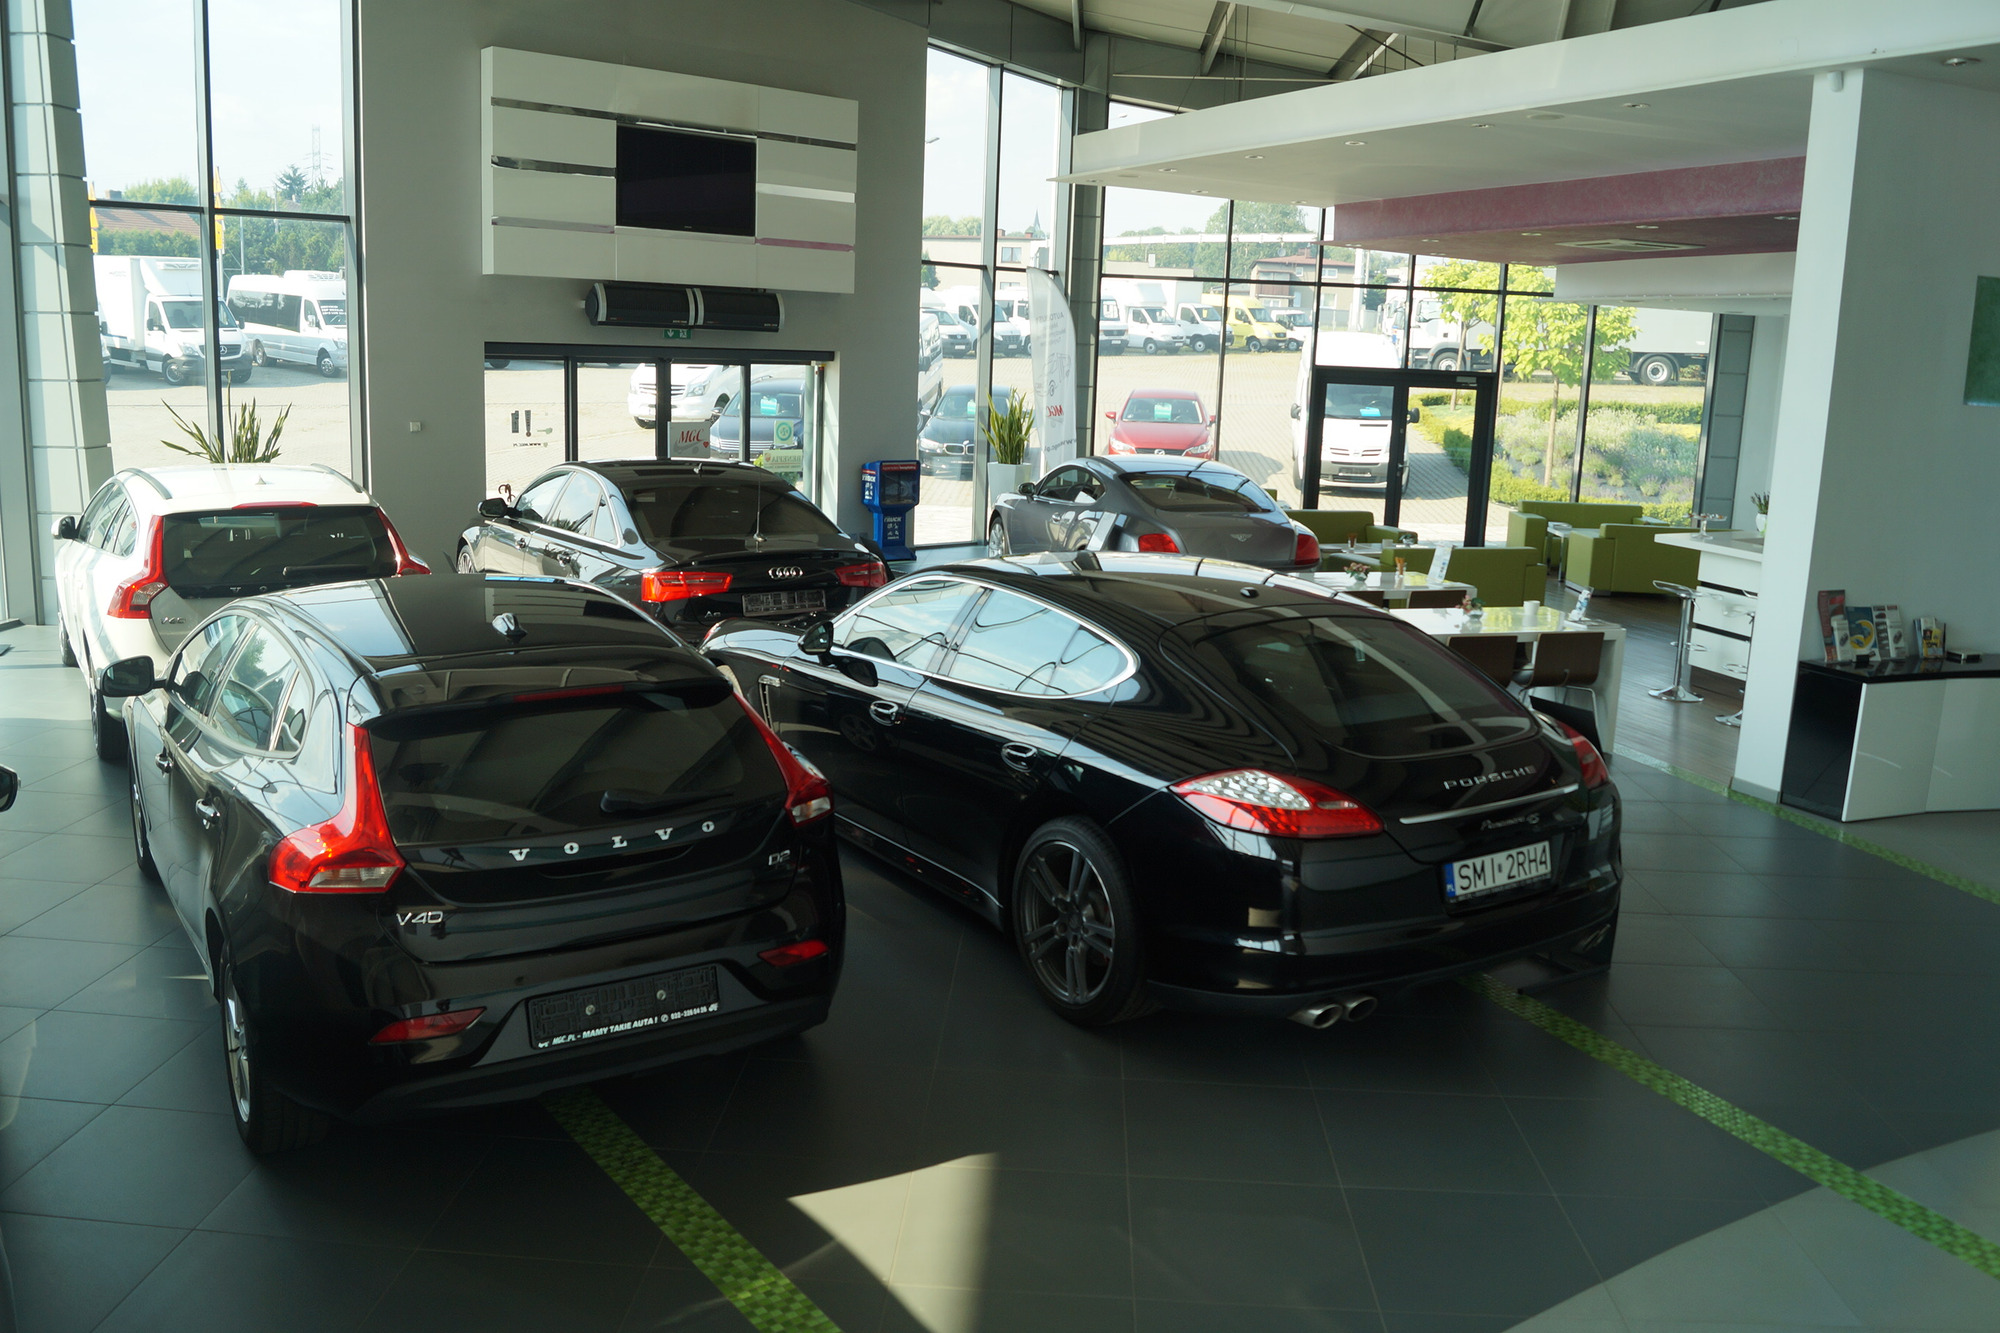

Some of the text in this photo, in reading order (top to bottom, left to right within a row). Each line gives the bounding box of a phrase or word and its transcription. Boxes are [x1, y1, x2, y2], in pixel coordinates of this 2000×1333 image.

[679, 428, 704, 444] MGC
[1443, 765, 1537, 790] PORSCHE
[509, 820, 715, 862] VOLVO
[767, 849, 791, 867] D2
[1458, 857, 1496, 891] SMI
[1506, 845, 1549, 880] 2RH4
[395, 909, 444, 926] V40
[582, 1026, 609, 1039] MAMY
[609, 1021, 632, 1033] TAKIE
